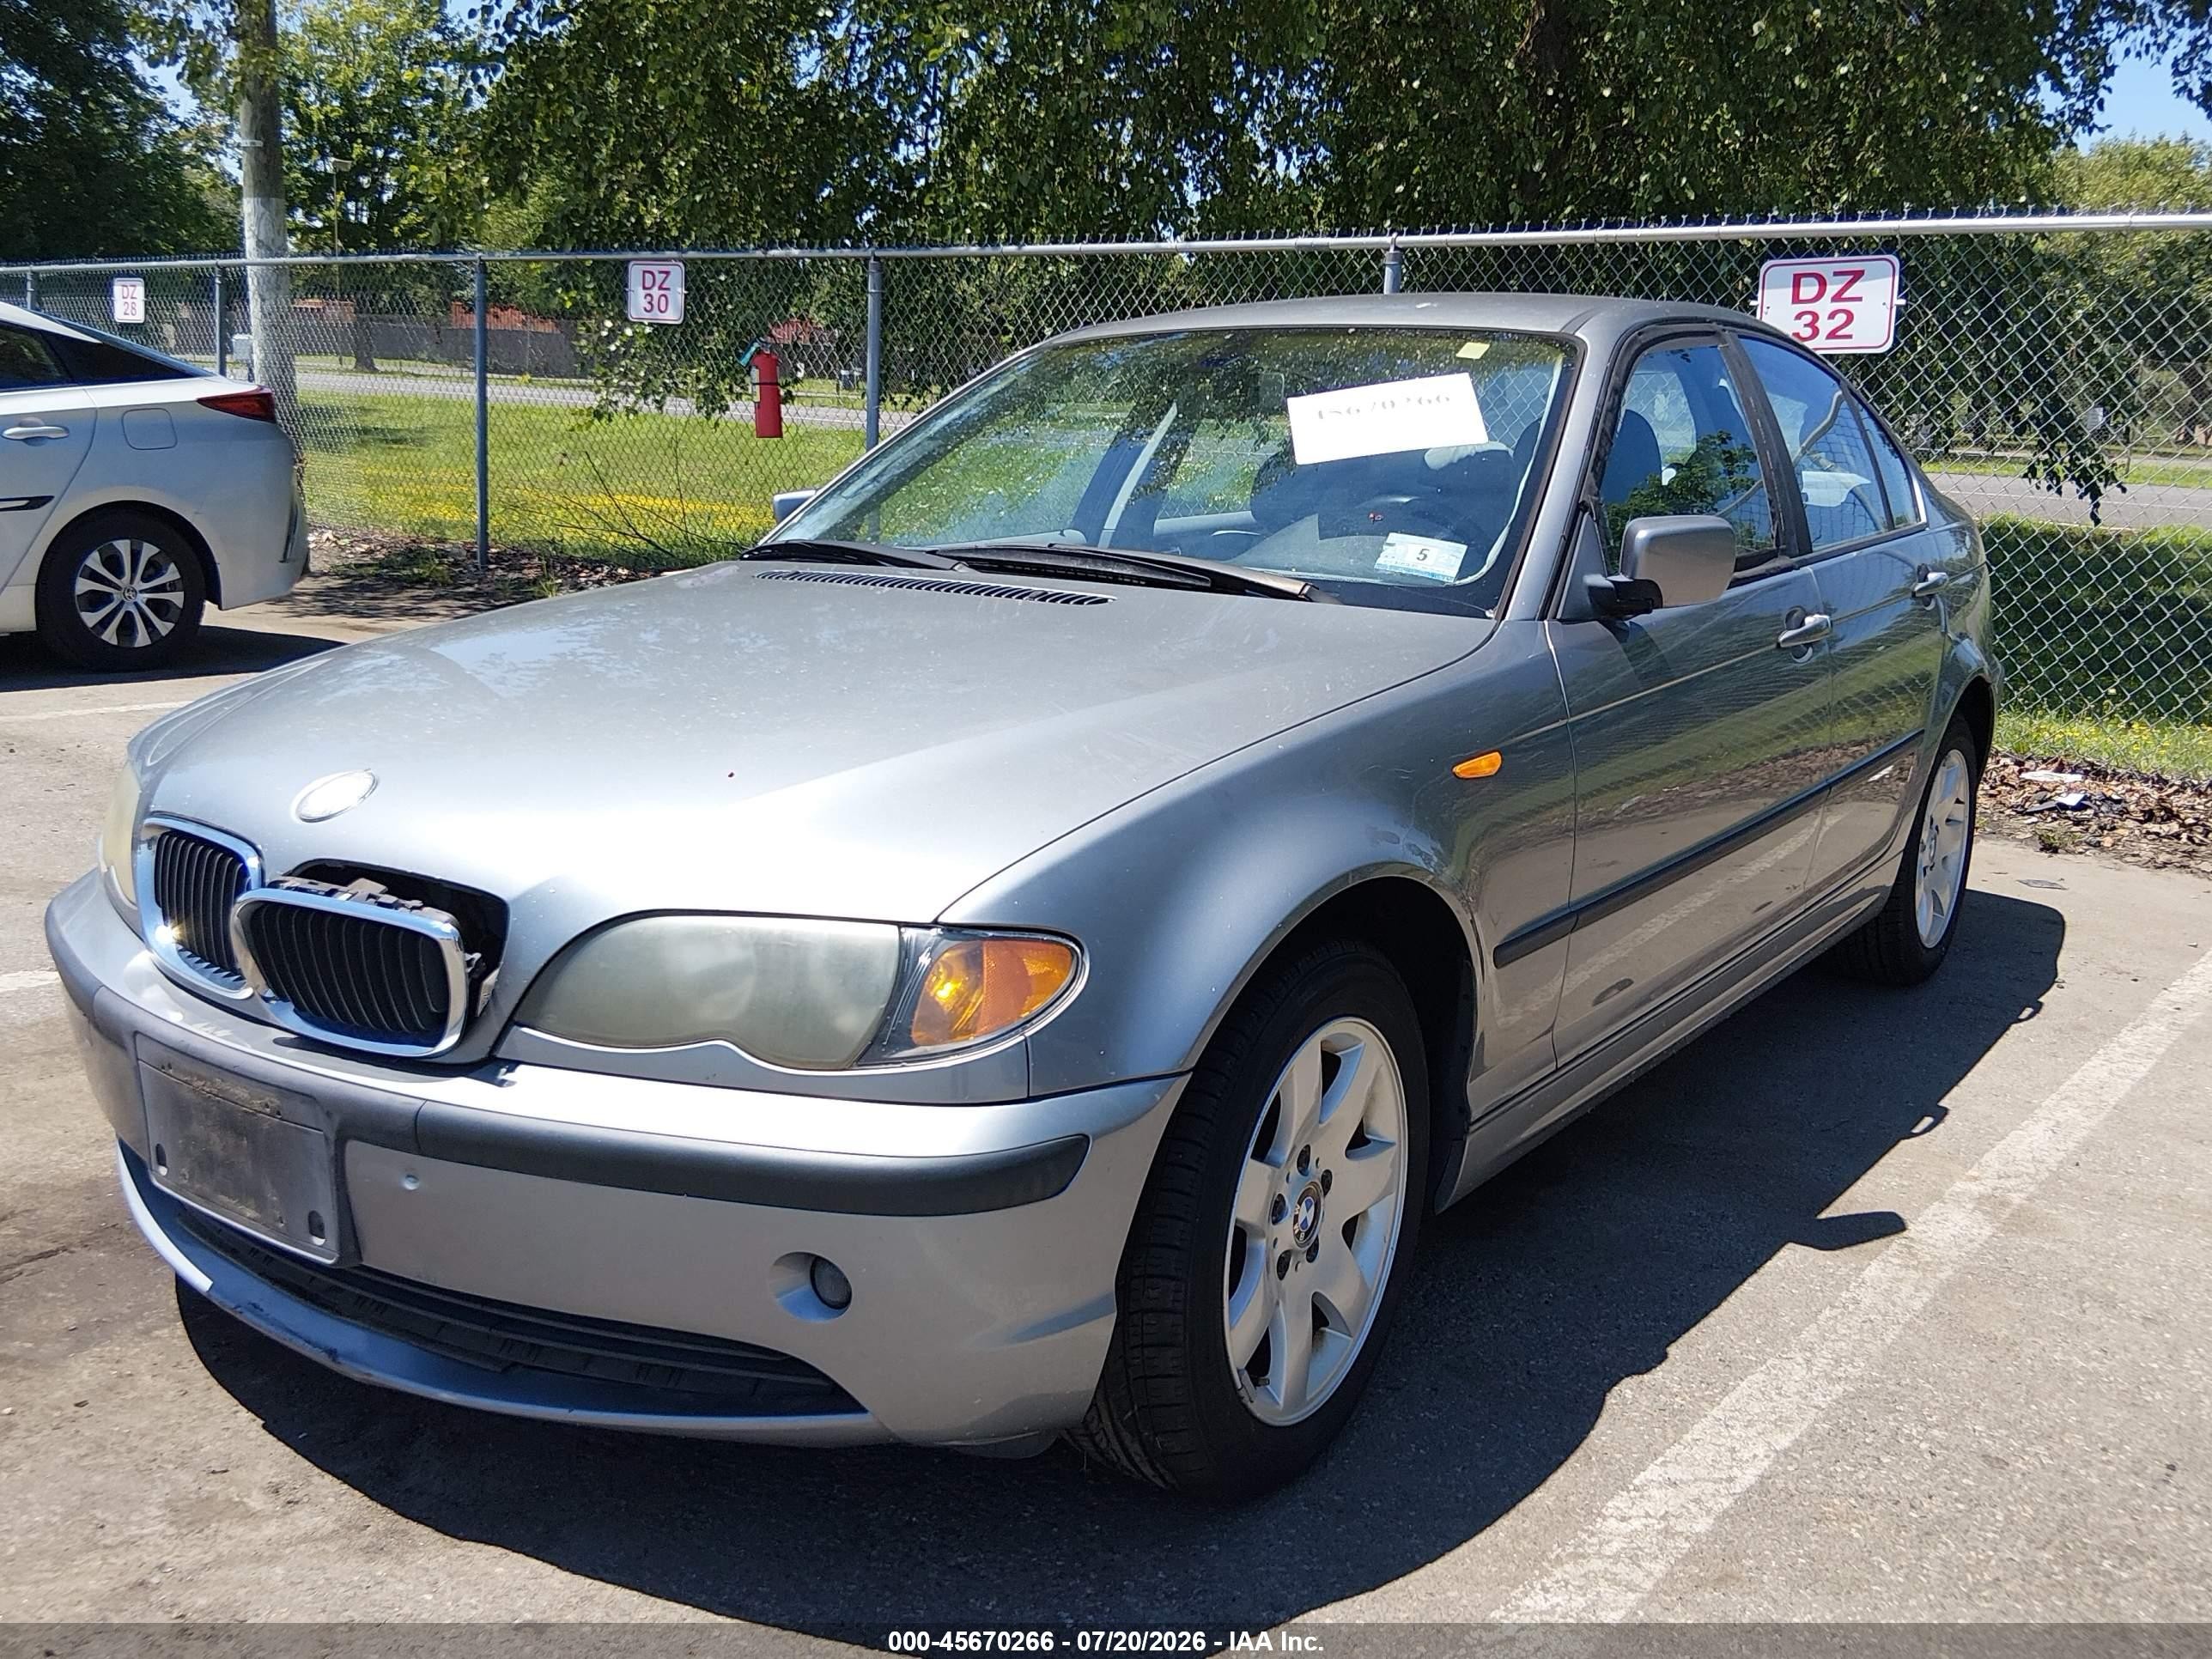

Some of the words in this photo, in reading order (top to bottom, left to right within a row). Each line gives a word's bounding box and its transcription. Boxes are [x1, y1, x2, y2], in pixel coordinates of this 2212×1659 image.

[641, 270, 672, 290] DZ
[1791, 270, 1865, 305] DZ
[121, 284, 137, 300] DZ
[123, 301, 137, 316] 28
[643, 293, 669, 314] 30
[1790, 308, 1855, 343] 32
[1416, 548, 1430, 562] 5
